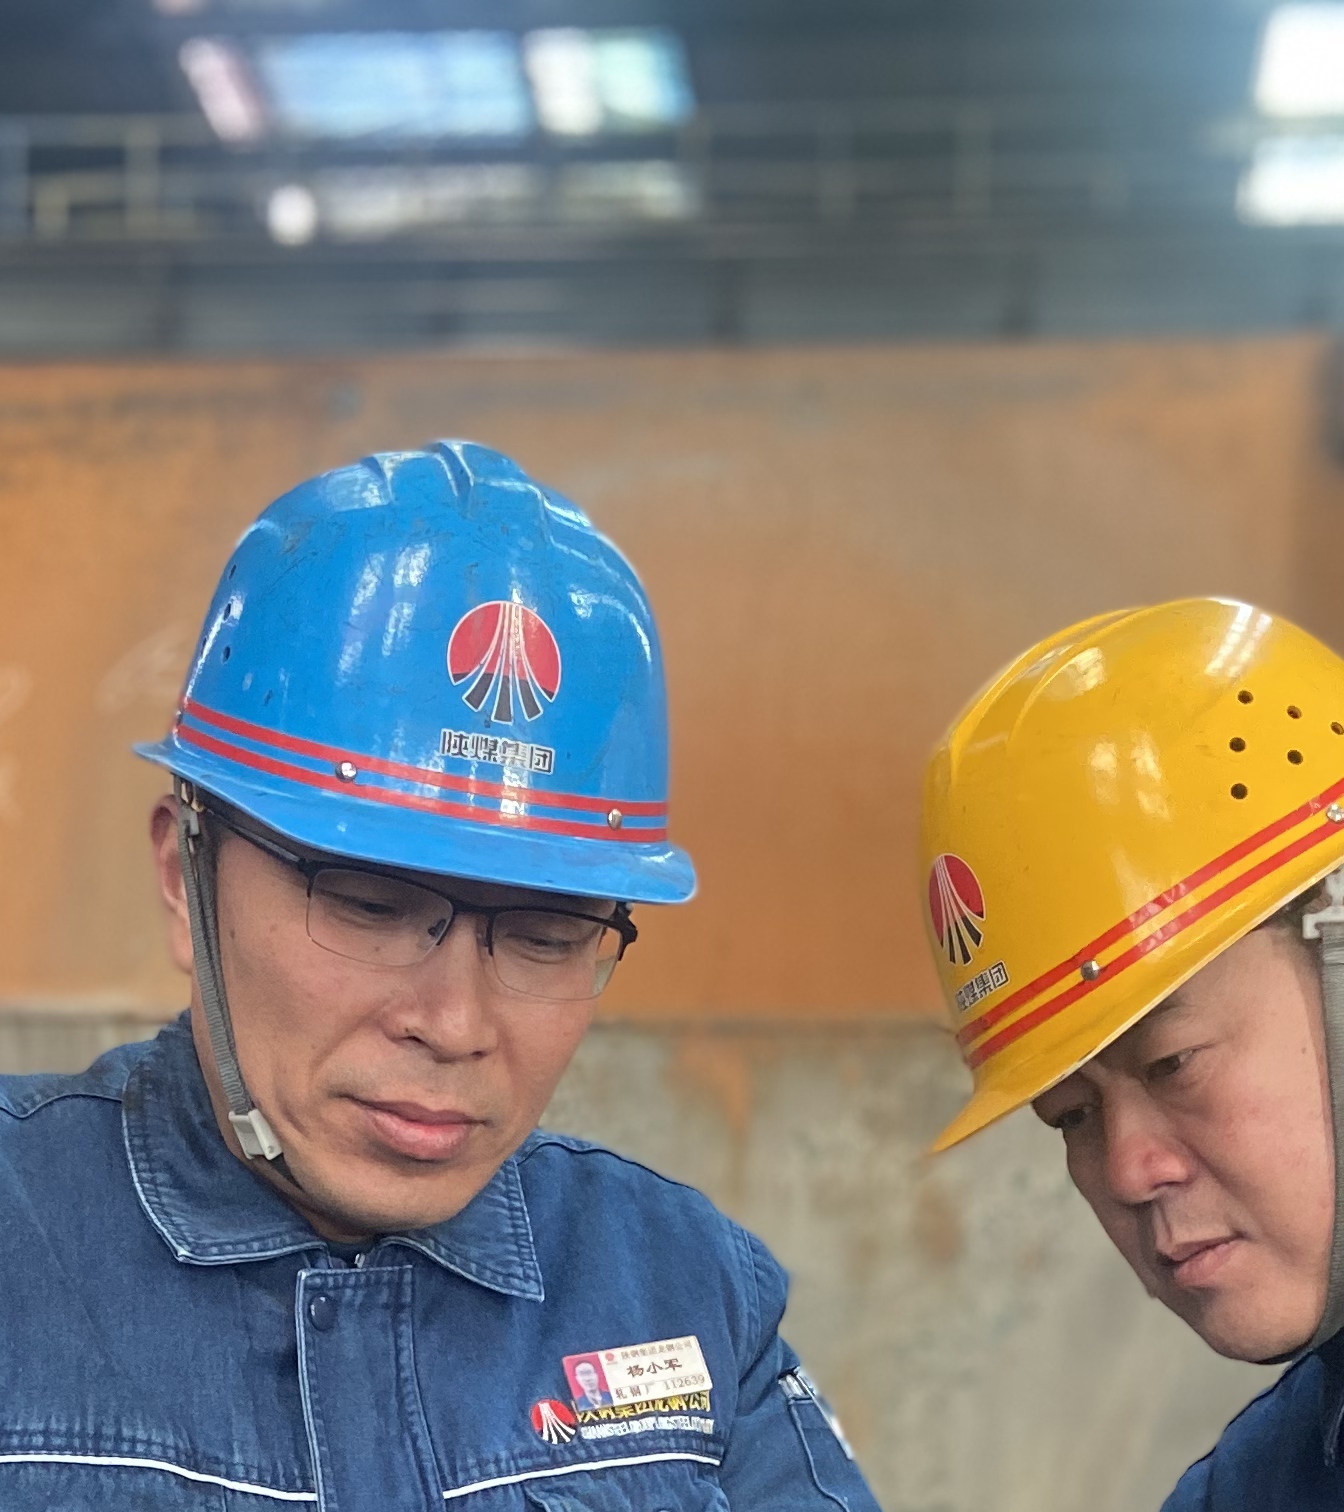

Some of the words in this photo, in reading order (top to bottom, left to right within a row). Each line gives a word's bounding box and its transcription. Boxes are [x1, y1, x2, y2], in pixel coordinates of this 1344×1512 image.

[440, 729, 554, 774] 陕煤集团
[627, 1358, 683, 1378] 杨小军
[664, 1375, 706, 1391] 112639
